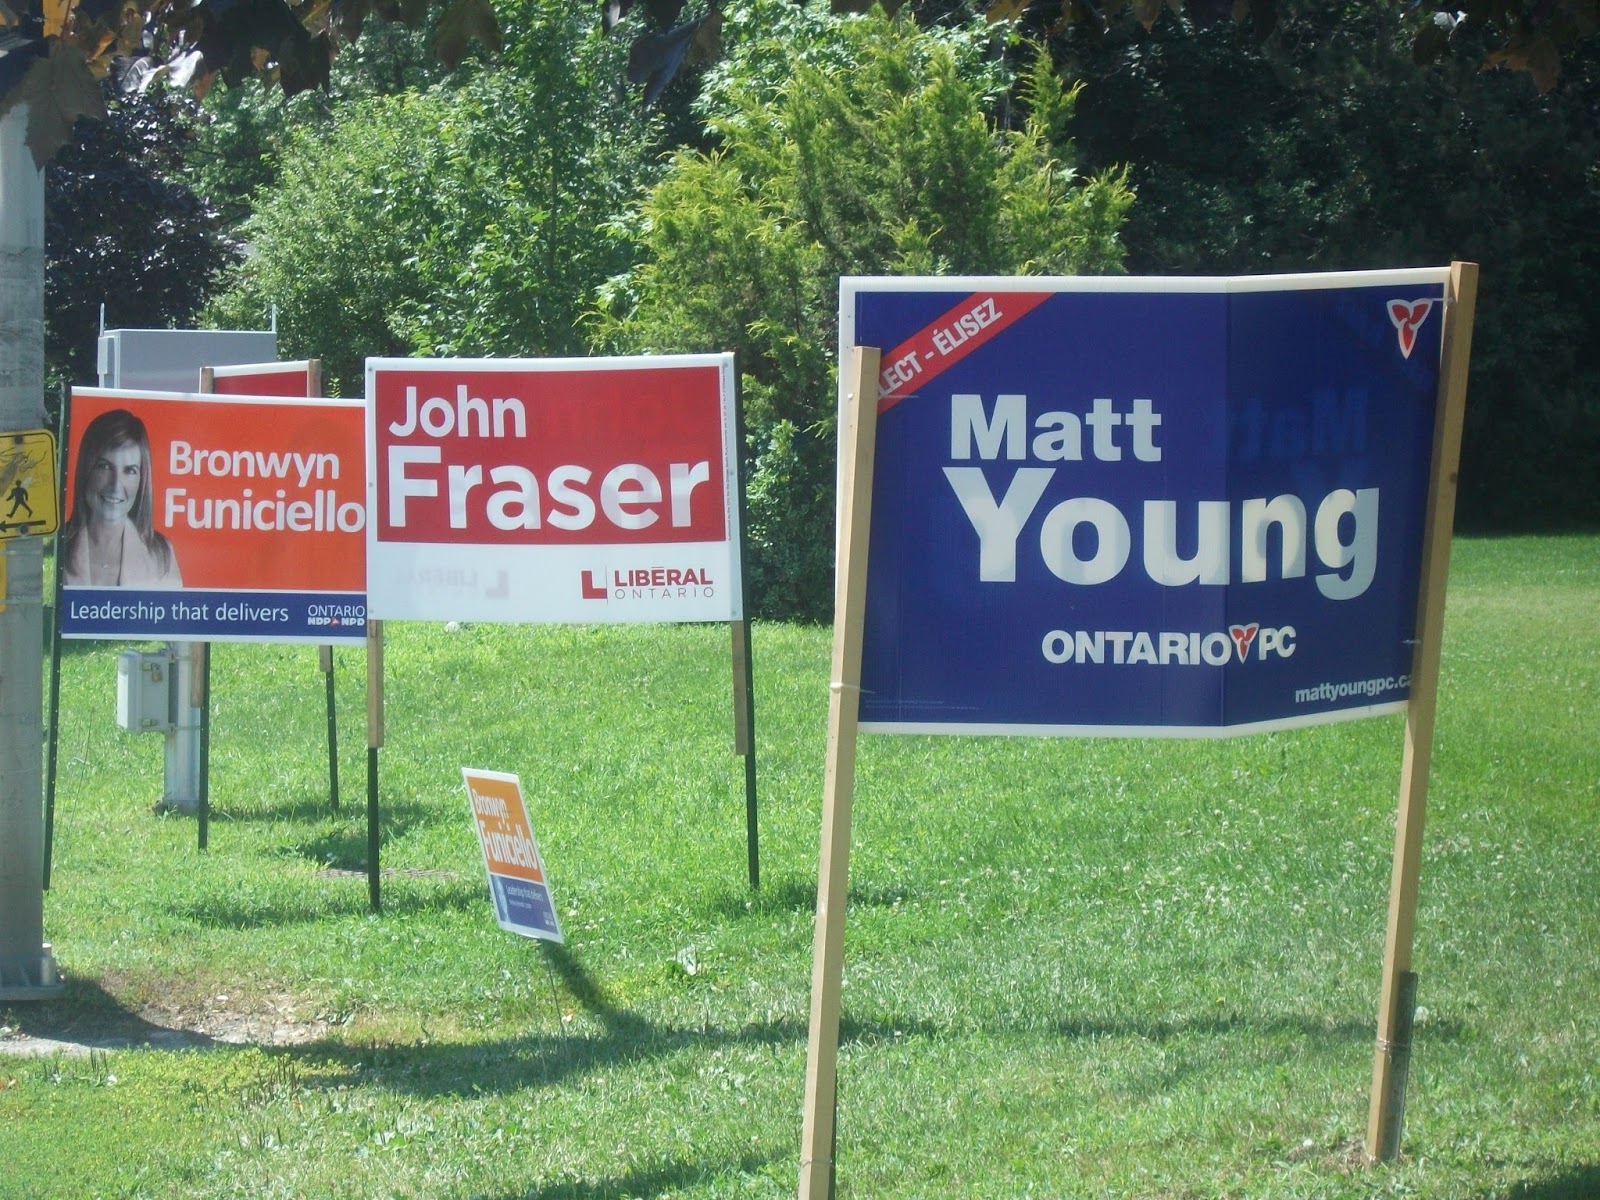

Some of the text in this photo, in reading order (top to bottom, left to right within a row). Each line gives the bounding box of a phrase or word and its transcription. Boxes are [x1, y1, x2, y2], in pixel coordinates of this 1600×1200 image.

[878, 351, 922, 397] LECT
[932, 297, 1003, 356] ÉLISEZ
[389, 384, 527, 437] John
[950, 394, 1162, 462] Matt
[169, 440, 339, 487] Bronwyn
[165, 488, 365, 533] Funiciello
[388, 445, 710, 531] Fraser
[942, 467, 1380, 601] Young
[70, 601, 289, 623] Leadership that delivers
[308, 604, 365, 617] ONTARIO
[615, 587, 715, 600] ONTARIO
[307, 617, 365, 626] NDP NPD
[1041, 625, 1297, 667] ONTARIO PC
[479, 819, 539, 870] Funiciello
